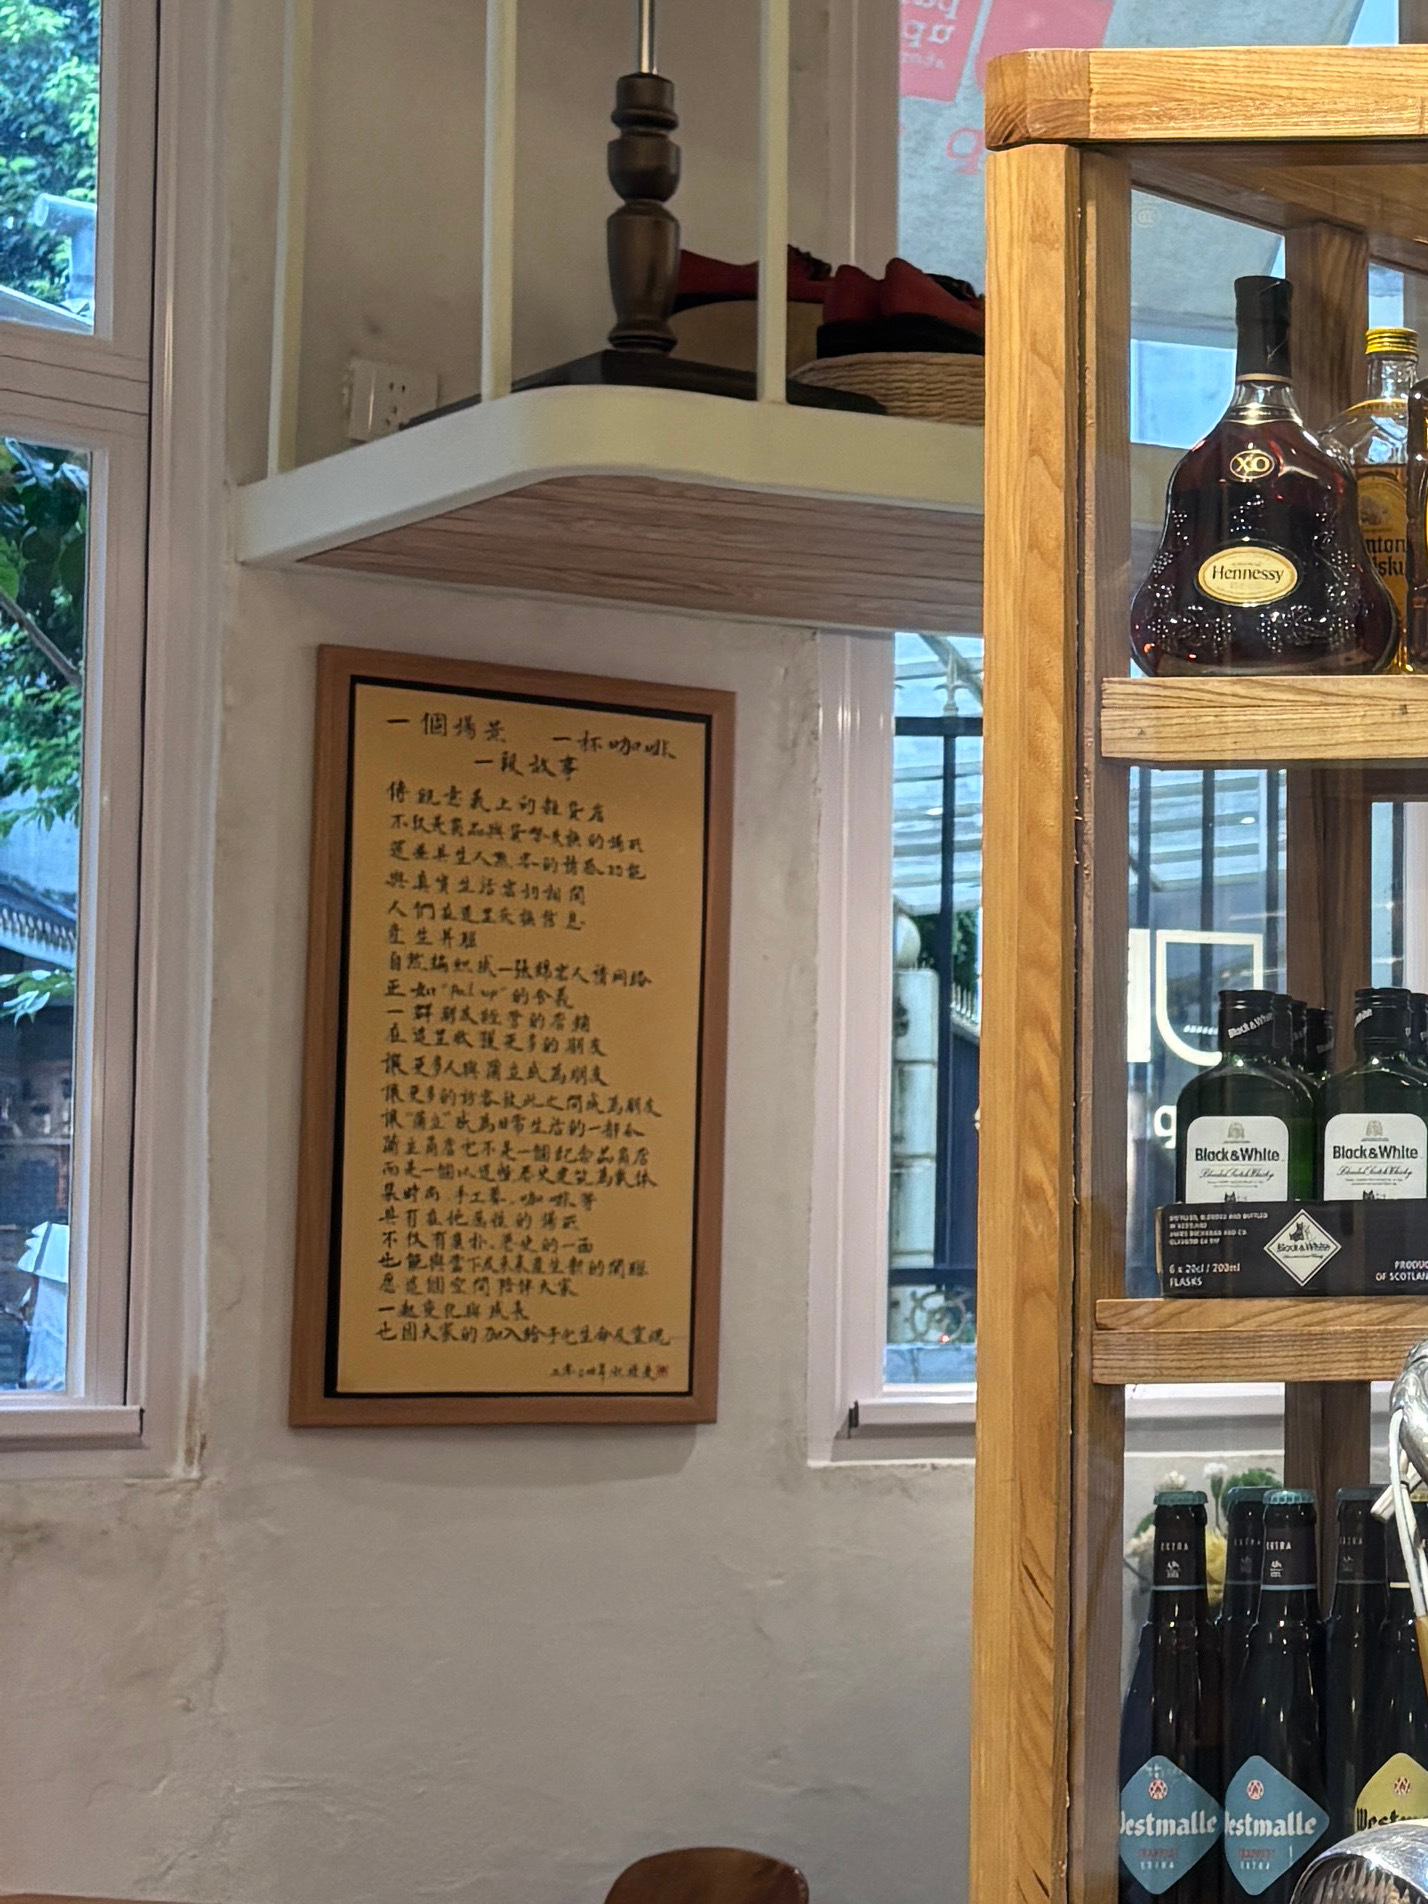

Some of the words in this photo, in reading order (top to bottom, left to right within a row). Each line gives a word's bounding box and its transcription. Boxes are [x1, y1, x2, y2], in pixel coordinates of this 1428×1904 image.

[1212, 565, 1284, 583] Hennessy
[553, 731, 676, 759] 一杯咖啡
[474, 751, 579, 781] 一段故事
[1169, 1277, 1202, 1287] FLASKS
[1375, 1272, 1388, 1282] OF
[1120, 1810, 1218, 1837] estmalle
[1224, 1810, 1317, 1837] estmalle
